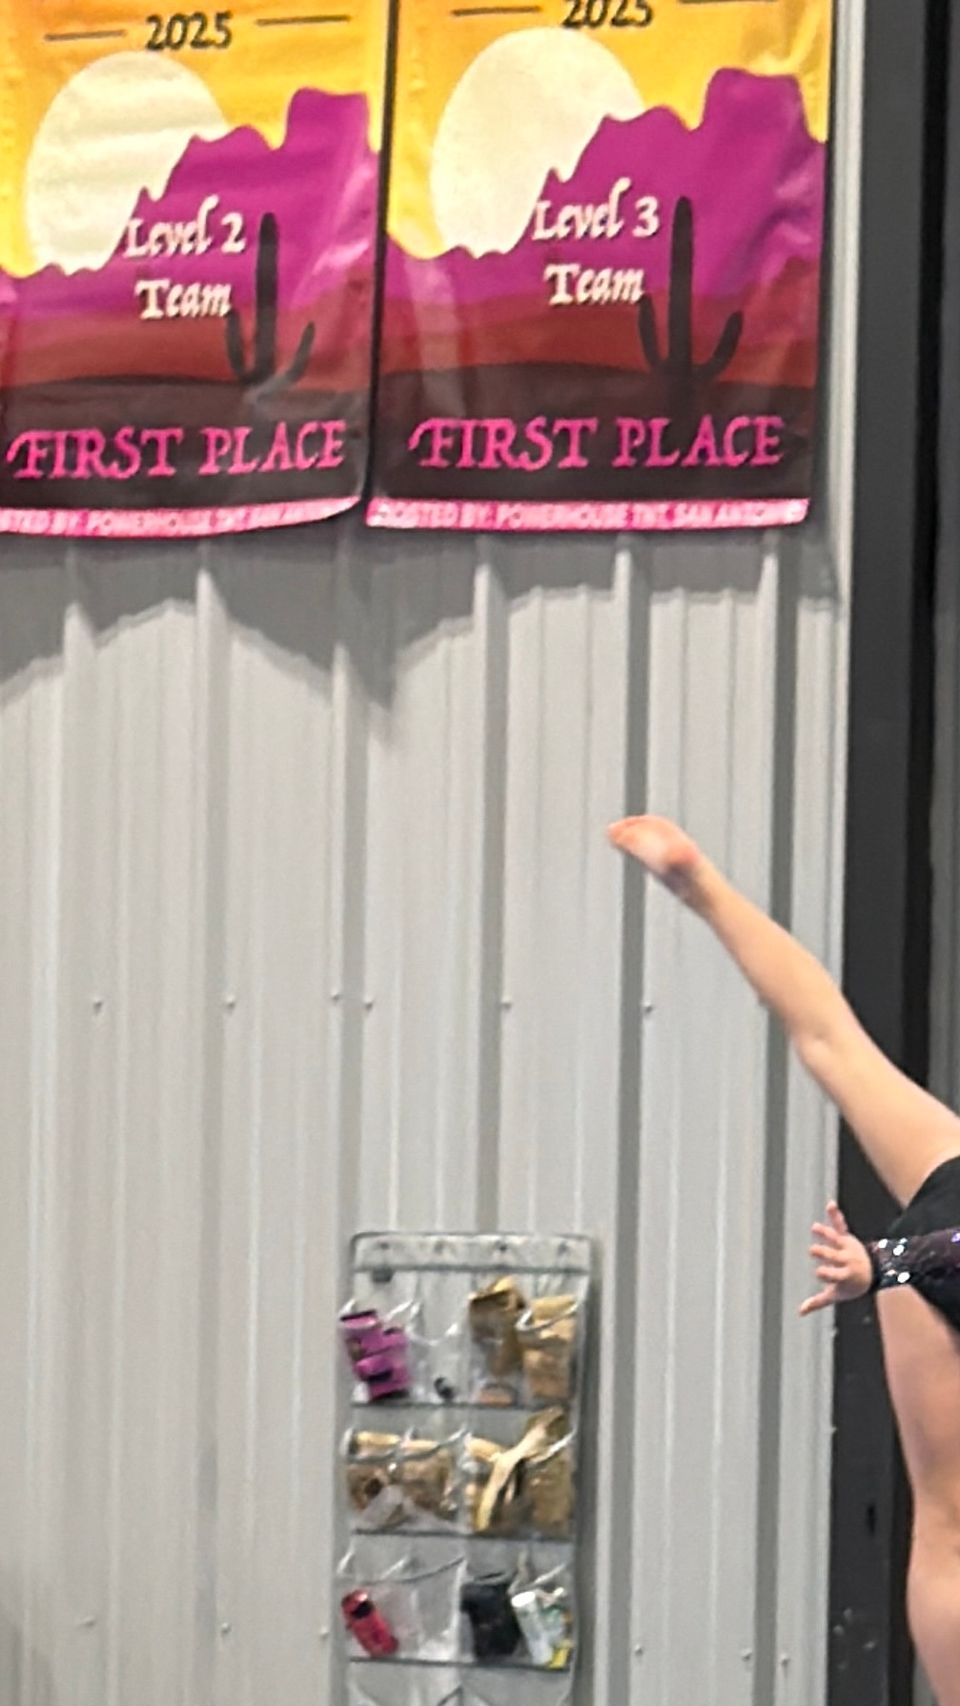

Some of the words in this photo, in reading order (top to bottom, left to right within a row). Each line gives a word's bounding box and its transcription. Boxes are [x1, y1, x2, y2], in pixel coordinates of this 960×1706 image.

[145, 11, 233, 51] 2025
[562, 0, 653, 29] 2025
[123, 195, 219, 259] Level
[221, 211, 247, 254] 2
[531, 177, 631, 241] Level
[632, 197, 660, 238] 3
[135, 279, 232, 320] Team
[544, 263, 645, 306] Team
[6, 426, 183, 480] FIRST
[199, 420, 348, 475] PLACE
[408, 416, 599, 472] FIRST
[612, 415, 786, 468] PLACE
